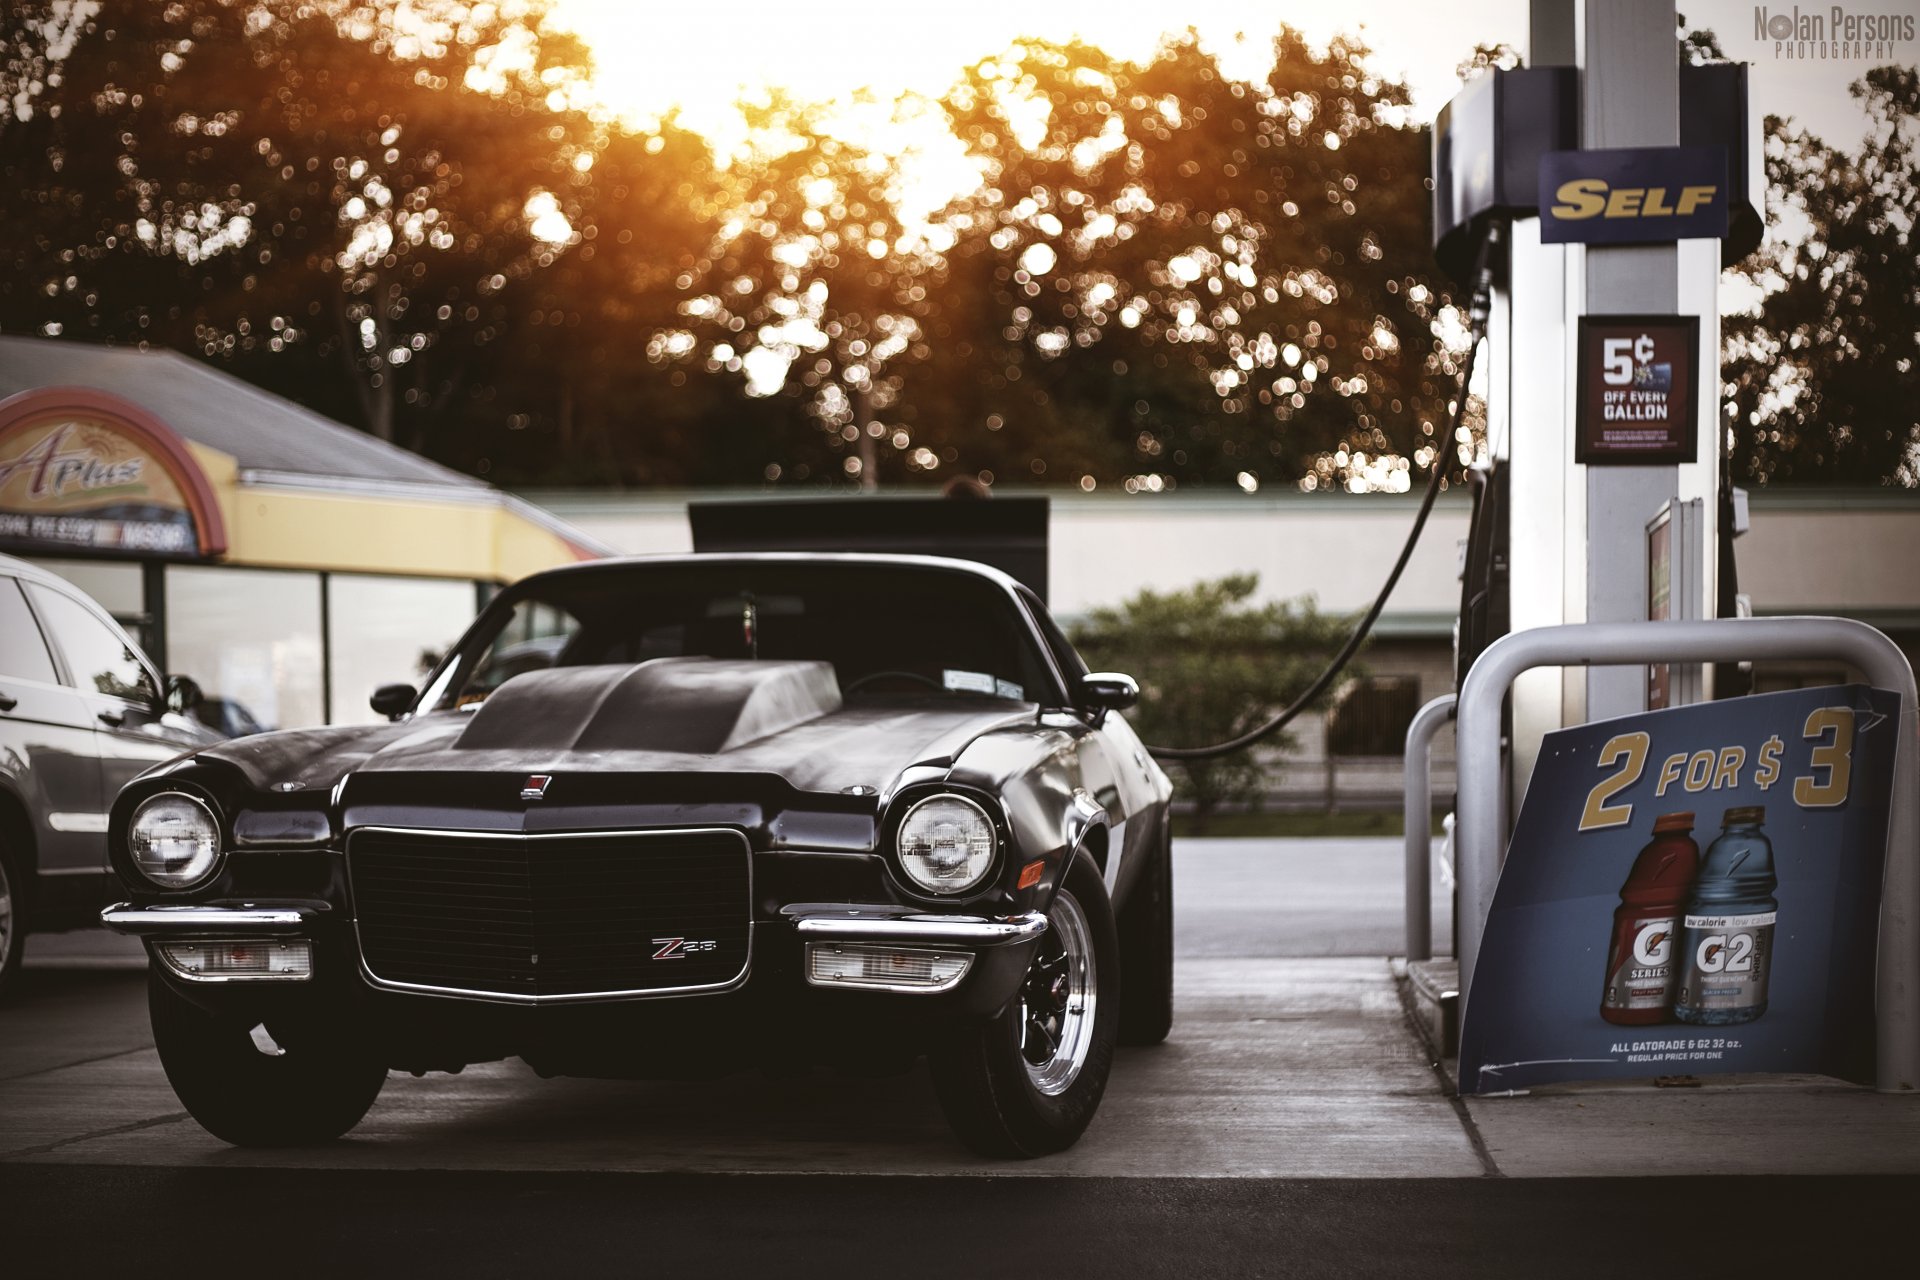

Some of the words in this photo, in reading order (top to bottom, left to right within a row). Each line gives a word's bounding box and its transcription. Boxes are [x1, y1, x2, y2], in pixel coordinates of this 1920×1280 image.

[1551, 178, 1717, 221] SELF
[1604, 391, 1626, 403] OFF
[1630, 391, 1668, 403] EVERY
[1604, 404, 1668, 420] GALLON
[1578, 731, 1650, 832] 2
[1655, 745, 1746, 797] FOR
[1697, 918, 1727, 927] calorie
[1732, 918, 1748, 926] low
[652, 937, 717, 960] Z28
[1633, 921, 1674, 966] G
[1696, 933, 1754, 974] G2
[1631, 967, 1670, 979] SERIES
[1611, 1043, 1630, 1053] ALL
[1632, 1040, 1686, 1052] GATORADE
[1688, 1040, 1696, 1050] &
[1698, 1039, 1710, 1049] G2
[1712, 1039, 1725, 1049] 32
[1727, 1040, 1742, 1049] oz.
[1627, 1053, 1663, 1062] REGULAR
[1665, 1052, 1688, 1061] PRICE
[1690, 1052, 1705, 1060] FOR
[1707, 1051, 1723, 1059] ONE
